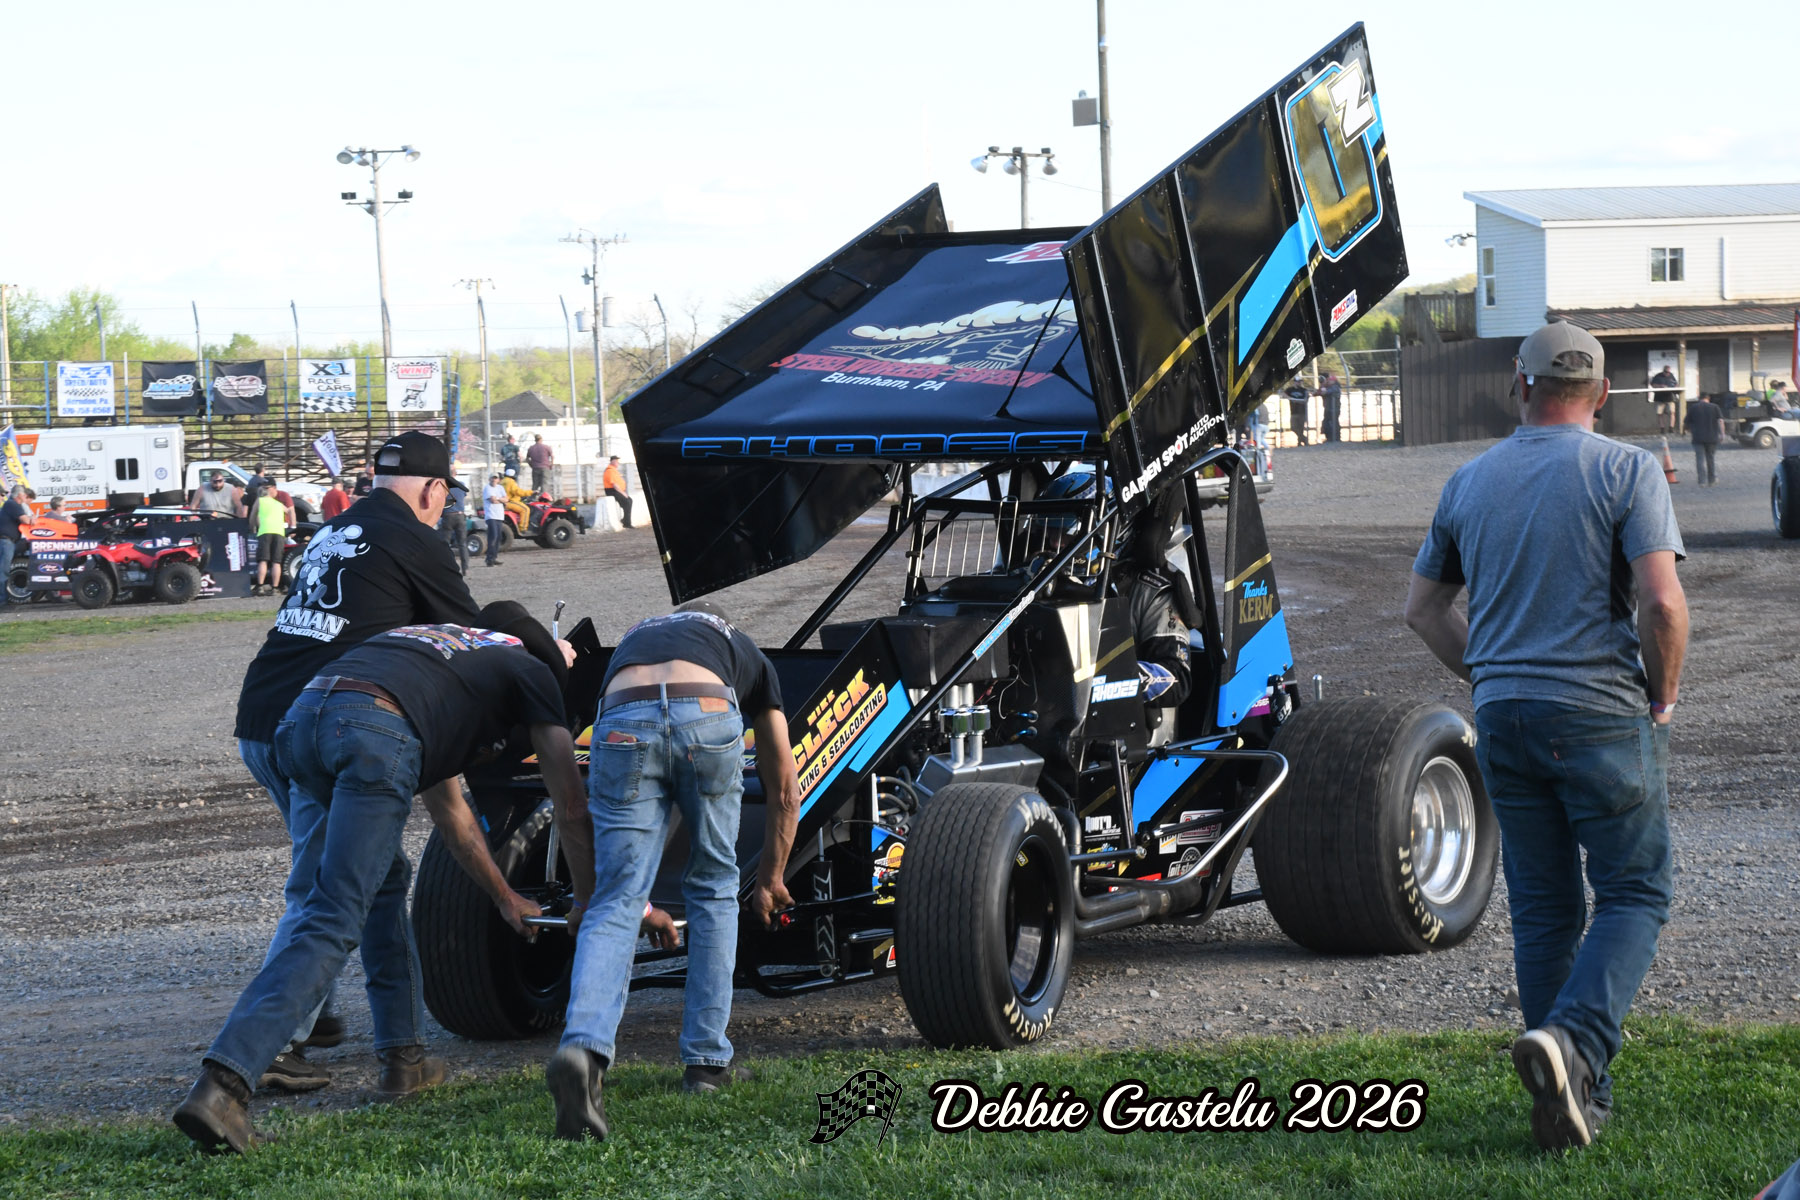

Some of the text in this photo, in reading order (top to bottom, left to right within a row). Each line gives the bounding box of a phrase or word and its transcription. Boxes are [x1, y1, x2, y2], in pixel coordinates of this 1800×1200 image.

[768, 353, 1054, 388] STEEL WORKER TAVERN
[820, 372, 947, 391] Burnham, PA
[1189, 413, 1225, 446] AUCTION
[1190, 414, 1209, 435] AUTO
[681, 430, 1089, 458] RHODES
[1122, 432, 1188, 503] GARDEN SPOT
[37, 485, 100, 496] AMBULANCE
[31, 541, 98, 554] BRENNEMAN
[1242, 579, 1268, 599] Thanks
[275, 607, 347, 637] ATMAN
[1239, 594, 1273, 624] KERM
[277, 625, 335, 643] RENEGADE
[1092, 680, 1139, 703] RHODES
[807, 689, 836, 727] MIKE
[821, 754, 828, 769] &
[829, 689, 883, 761] SEALCOATING
